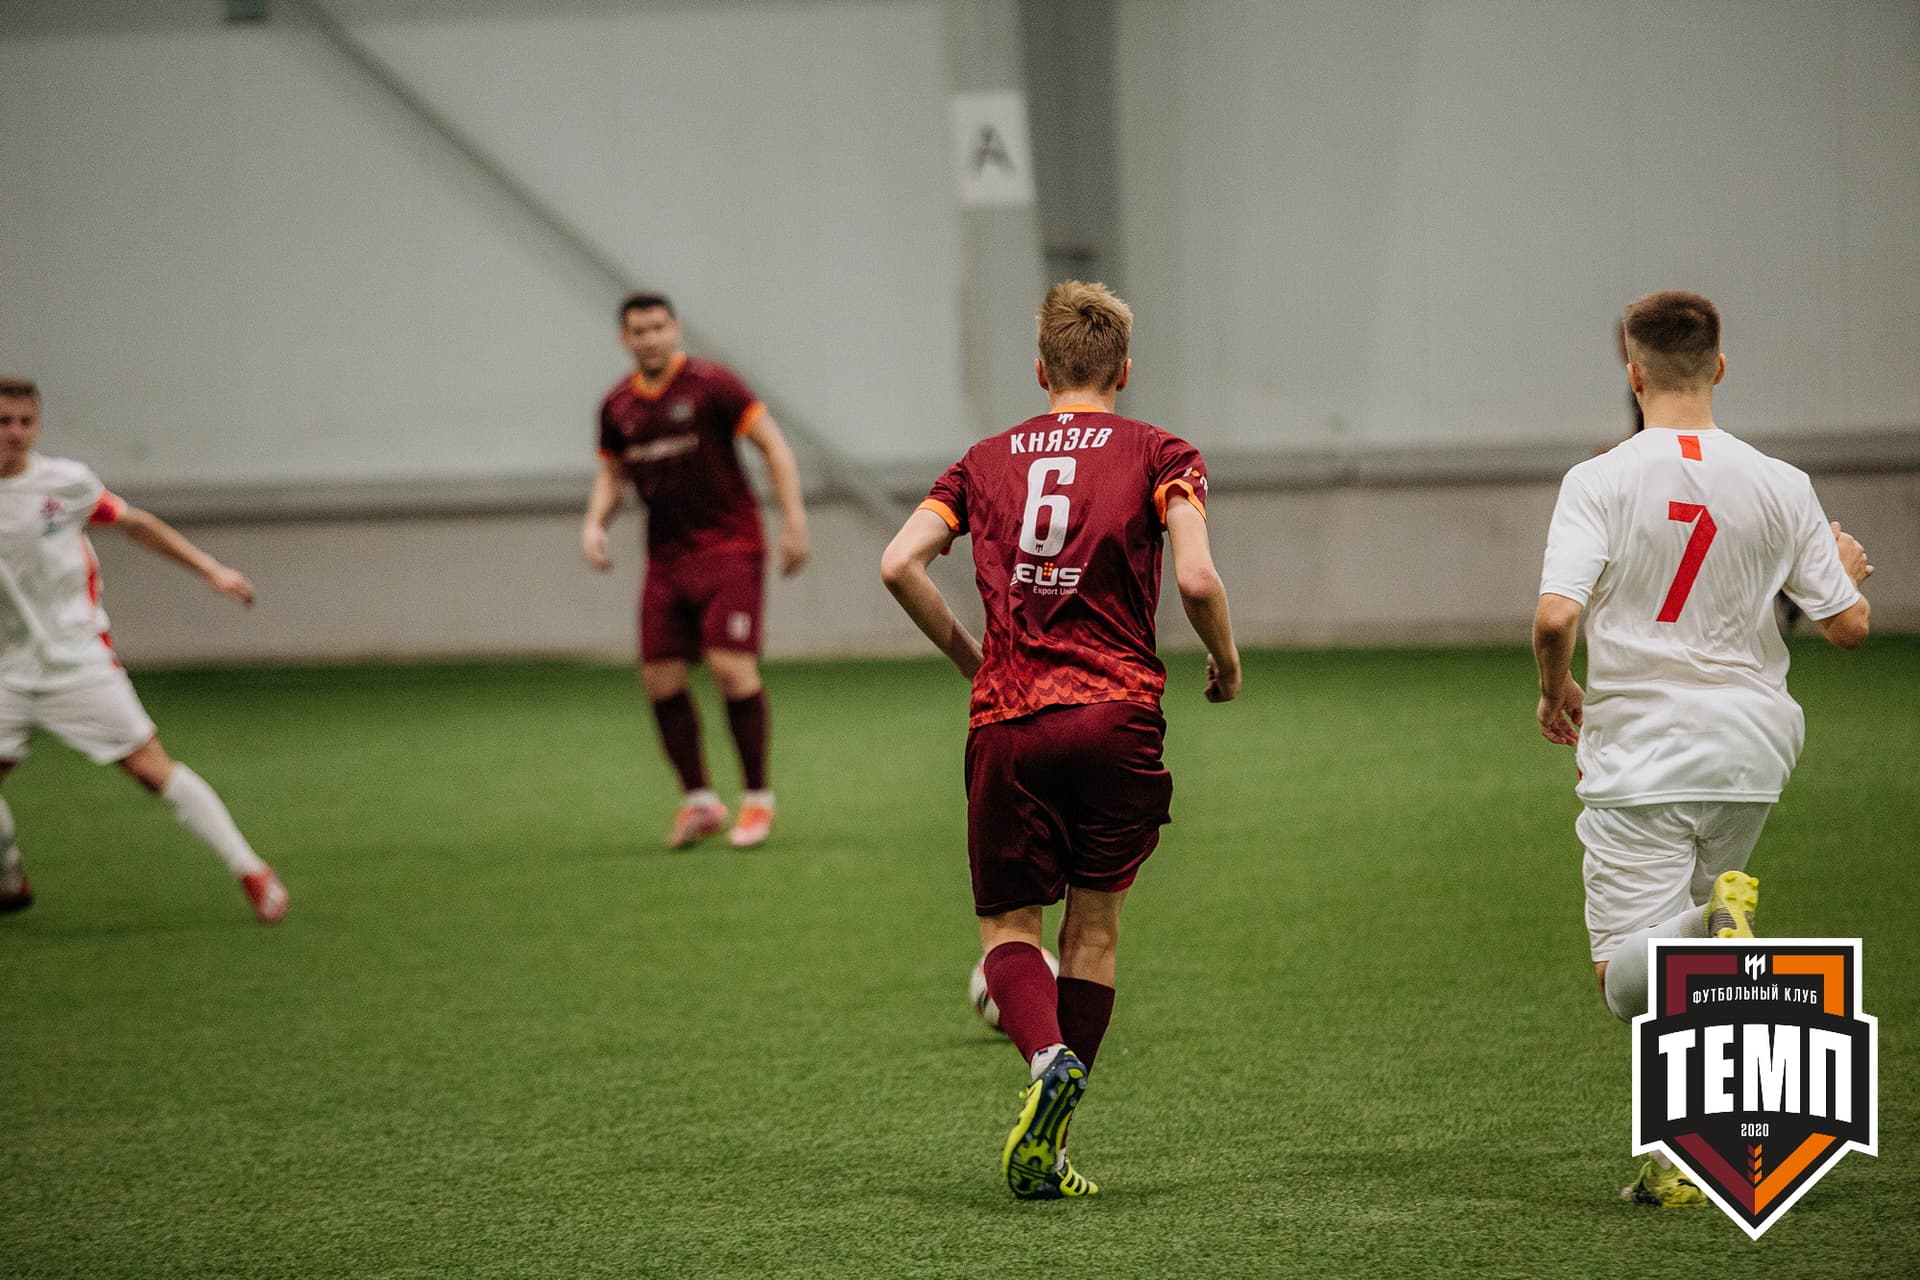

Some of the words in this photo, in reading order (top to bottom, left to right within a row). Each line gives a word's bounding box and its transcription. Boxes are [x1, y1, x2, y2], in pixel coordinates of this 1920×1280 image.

[1010, 427, 1113, 455] КНЯЗЕВ
[1019, 456, 1077, 557] 6
[1010, 562, 1082, 587] EUS
[1656, 501, 1718, 623] 7
[1033, 585, 1058, 596] Export
